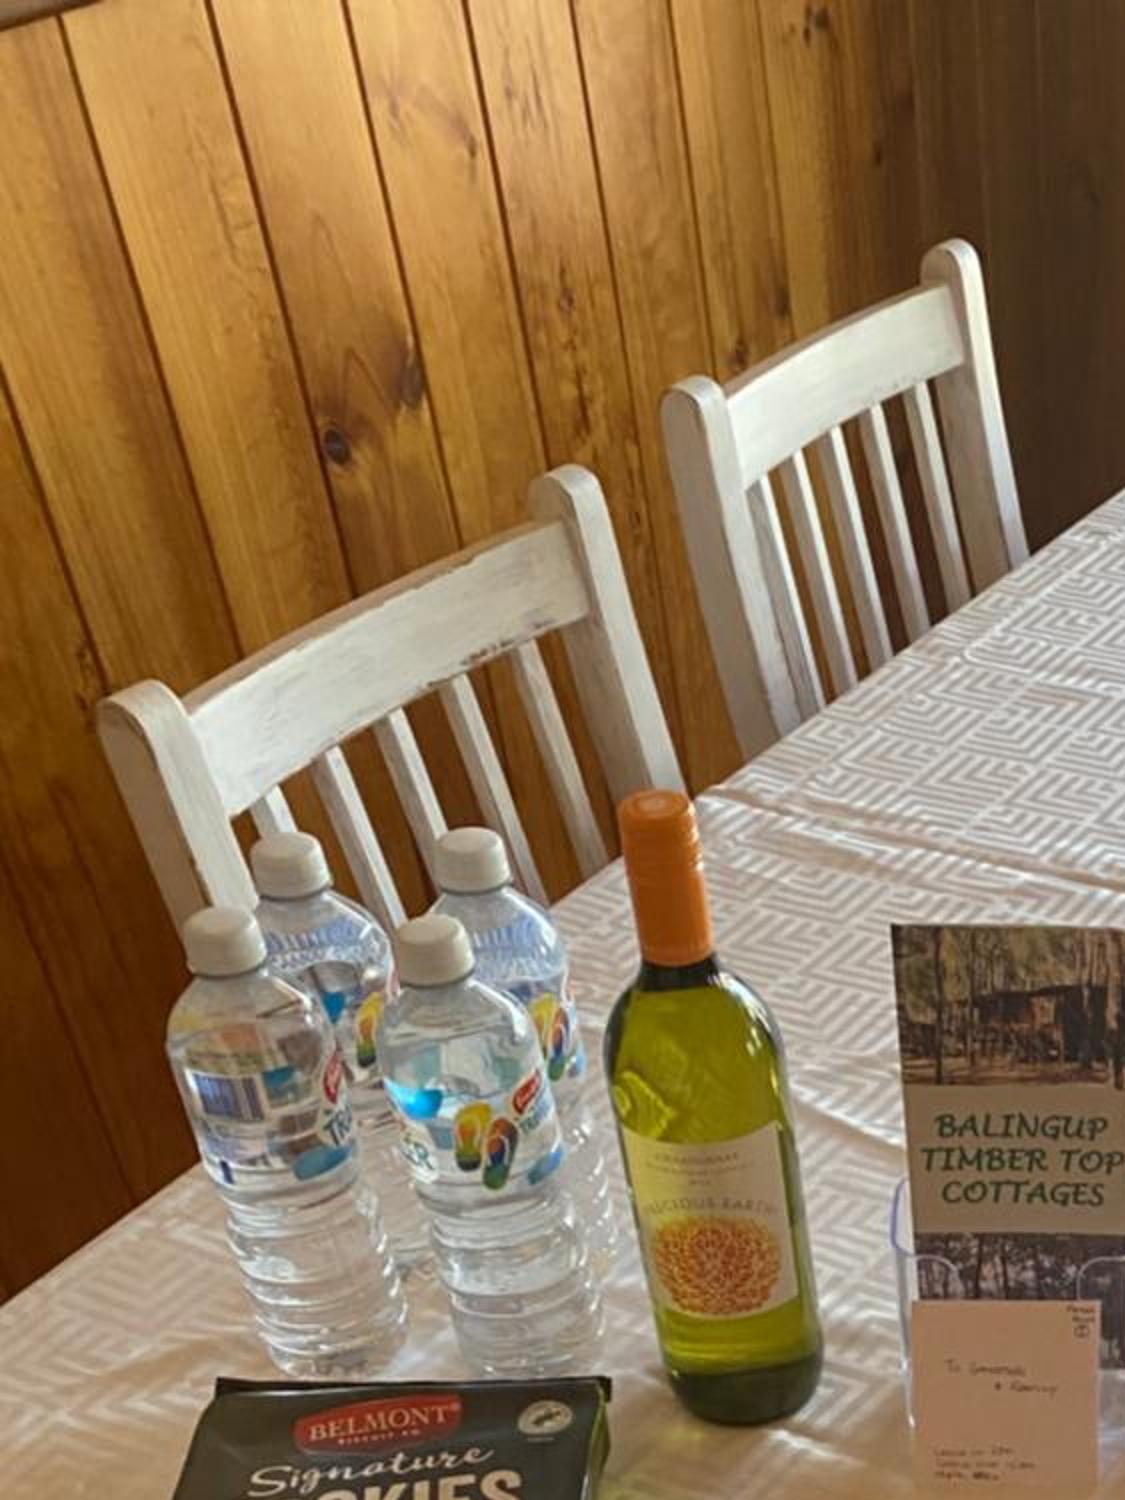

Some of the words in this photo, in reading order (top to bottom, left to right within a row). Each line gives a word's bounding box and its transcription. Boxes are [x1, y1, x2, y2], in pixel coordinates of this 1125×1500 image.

[935, 1112, 1108, 1141] BALINGUP
[922, 1147, 1048, 1172] TIMBER
[1060, 1149, 1125, 1175] TOP
[942, 1180, 1105, 1207] COTTAGES
[308, 1404, 449, 1442] BELMONT
[247, 1447, 494, 1497] Signature
